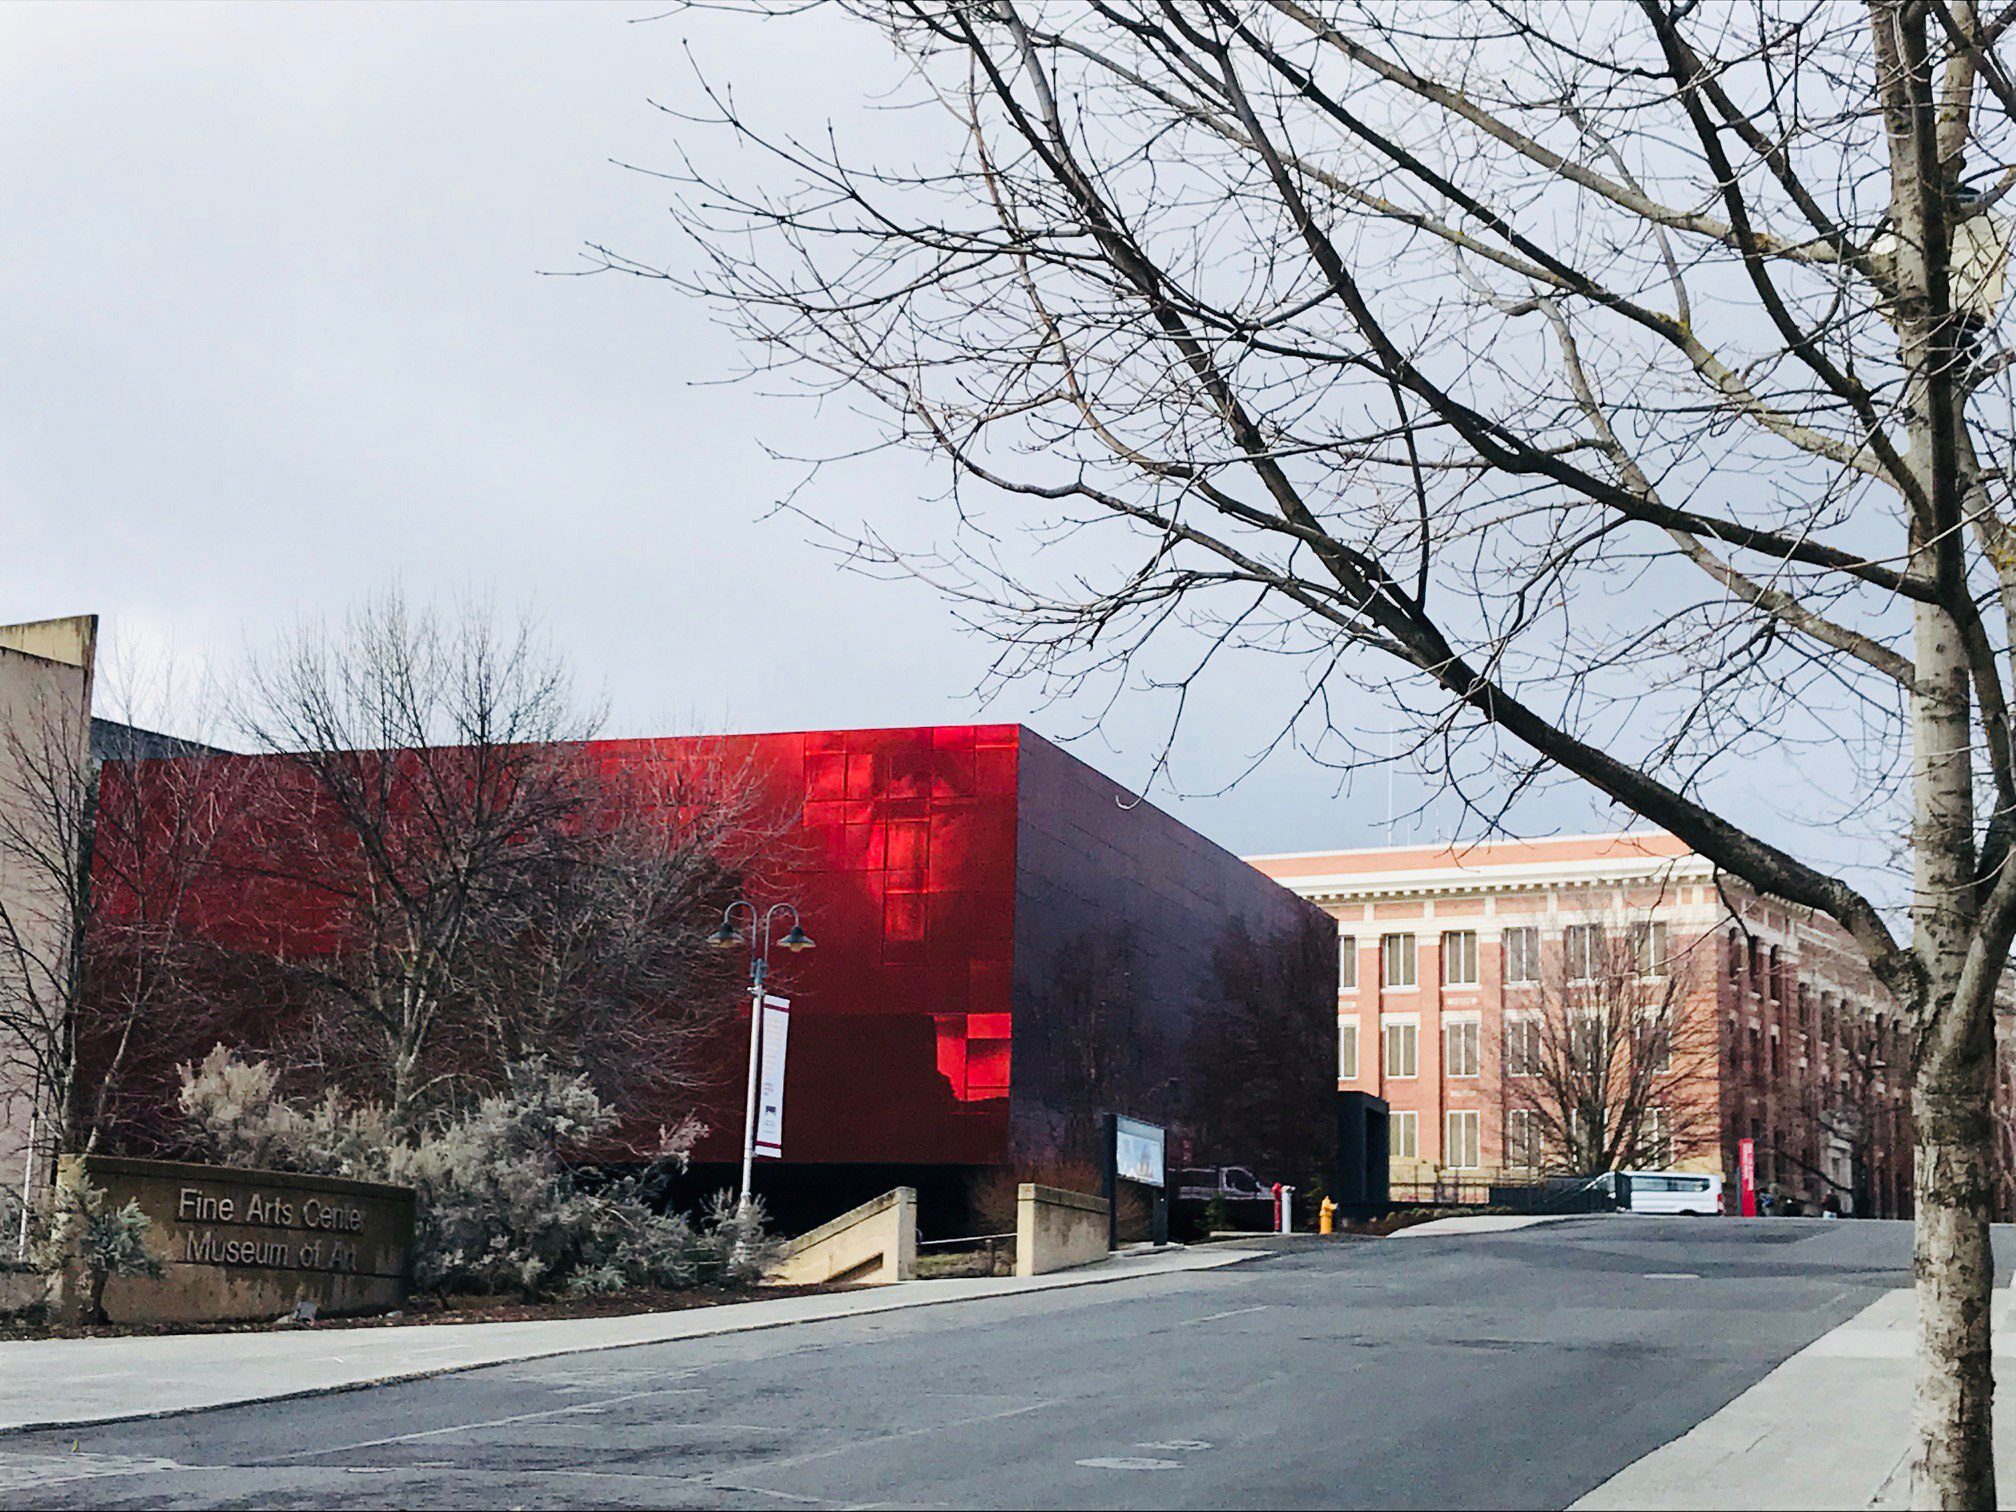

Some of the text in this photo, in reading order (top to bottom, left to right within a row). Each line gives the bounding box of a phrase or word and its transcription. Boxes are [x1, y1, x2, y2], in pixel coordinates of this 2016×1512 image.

[178, 1187, 366, 1231] Fine Arts Cente
[185, 1230, 357, 1270] Museum of Art
